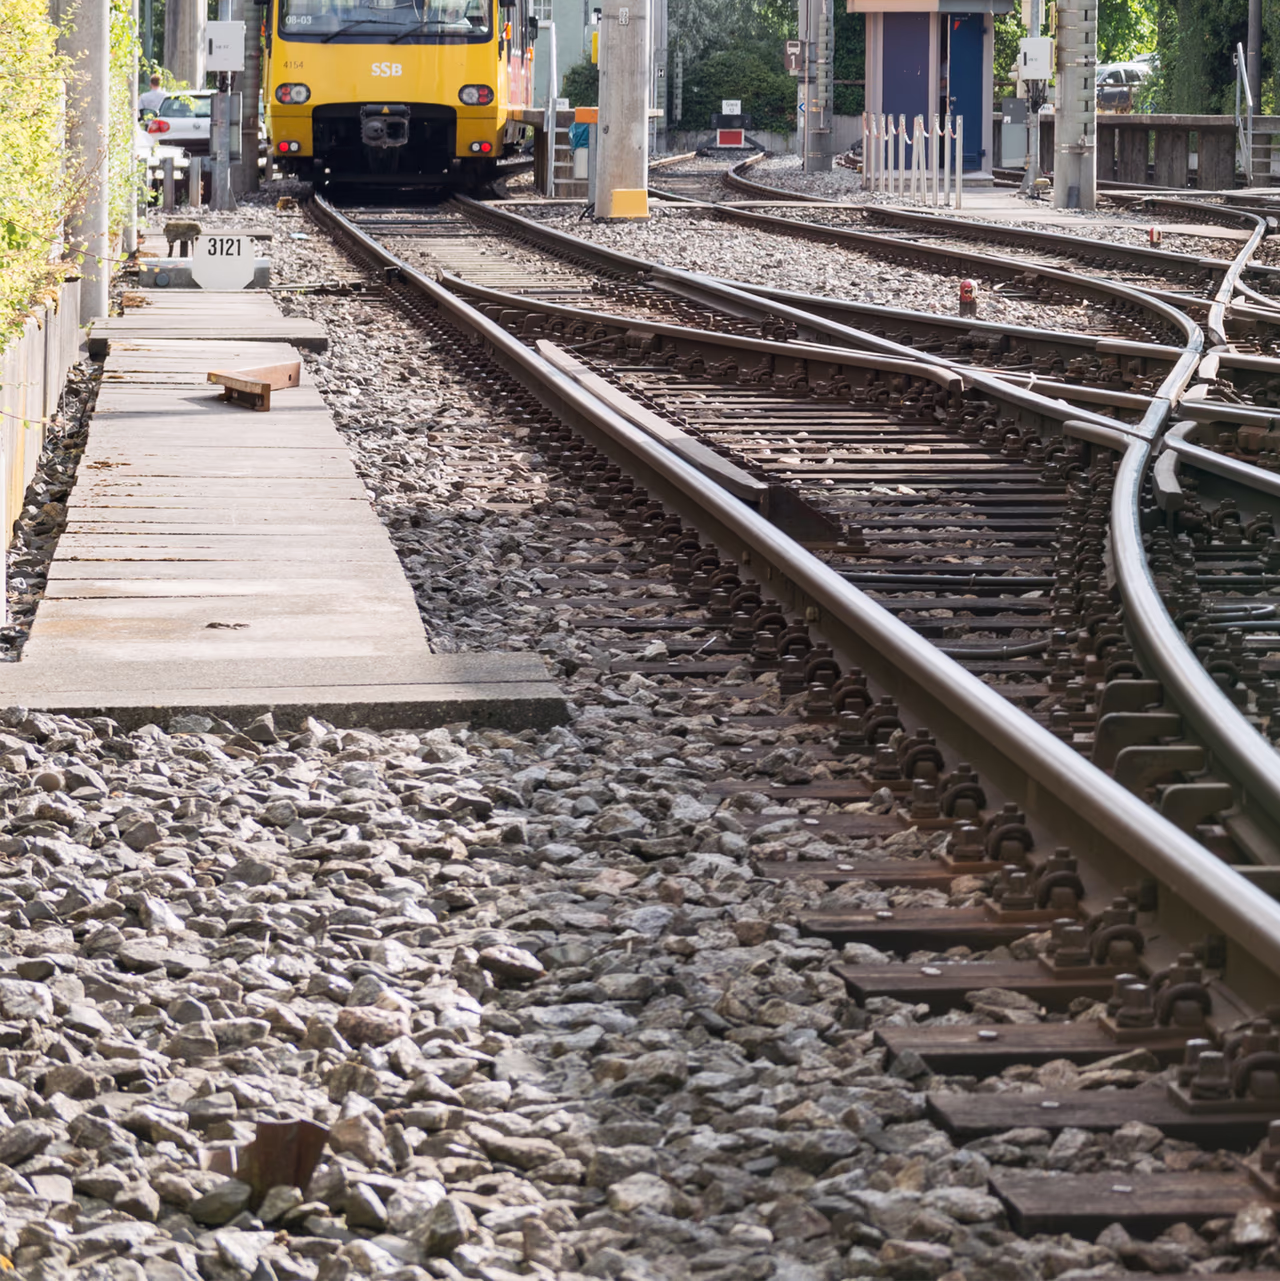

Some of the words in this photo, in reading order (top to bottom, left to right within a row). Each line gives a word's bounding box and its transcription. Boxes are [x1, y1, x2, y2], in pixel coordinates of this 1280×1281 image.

[285, 15, 312, 25] 08-03
[283, 60, 304, 70] 4154
[371, 61, 403, 77] SSB
[790, 55, 796, 69] 1
[208, 237, 241, 256] 3121
